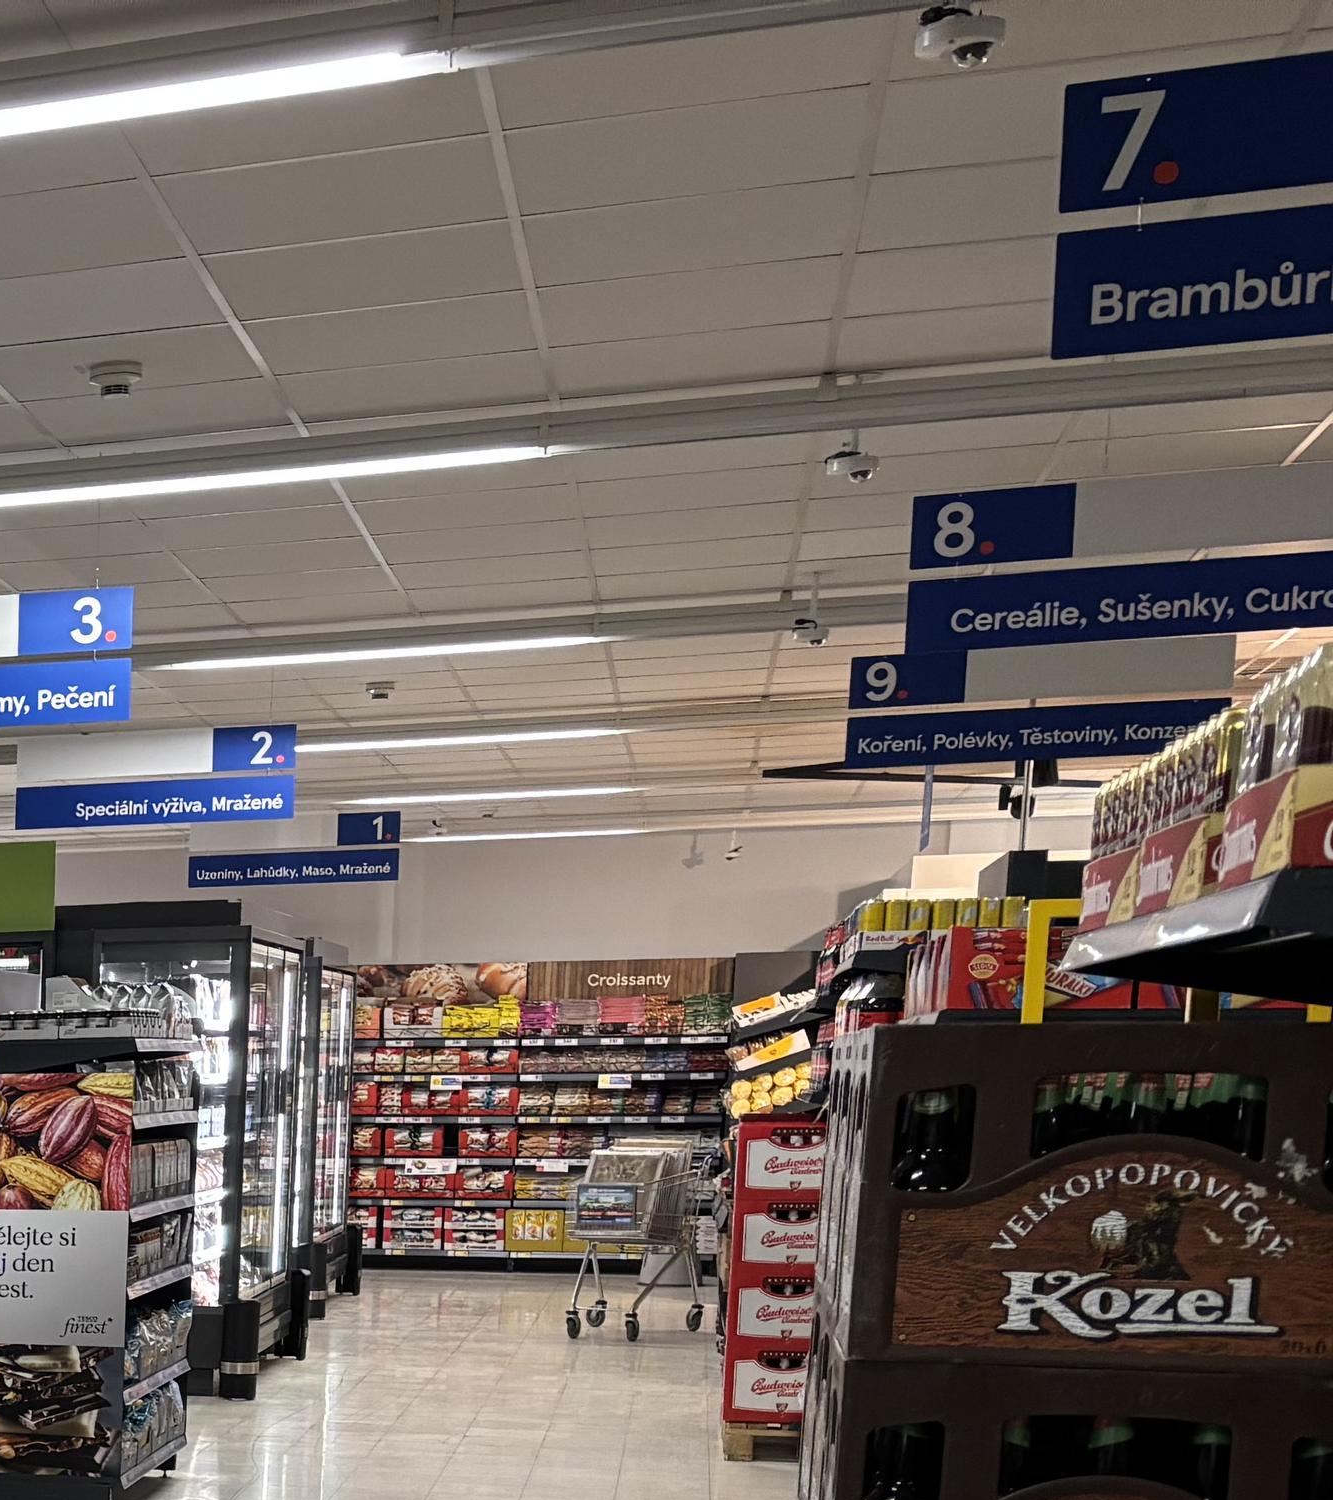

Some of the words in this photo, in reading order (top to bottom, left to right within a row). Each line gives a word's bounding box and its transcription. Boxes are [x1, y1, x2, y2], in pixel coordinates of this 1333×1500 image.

[1090, 261, 1333, 325] Brambůr
[950, 601, 1087, 634] Cereálie,
[1097, 592, 1235, 624] Sušenky,
[37, 684, 116, 712] Pečení
[857, 732, 927, 755] Koření,
[933, 730, 1015, 751] Polévky,
[1019, 725, 1119, 746] Těstoviny,
[75, 798, 148, 820] Speciální
[152, 796, 207, 818] výživa,
[212, 791, 284, 812] Mražené
[196, 865, 243, 884] Uzeniny,
[246, 862, 299, 882] Lahůdky,
[302, 863, 337, 879] Maso,
[340, 861, 391, 878] Mražené
[588, 972, 671, 989] Croissanty
[990, 1163, 1295, 1258] VELKOPOPOVICKÝ
[59, 1227, 76, 1246] si
[13, 1252, 54, 1272] den
[997, 1270, 1280, 1339] Kozel
